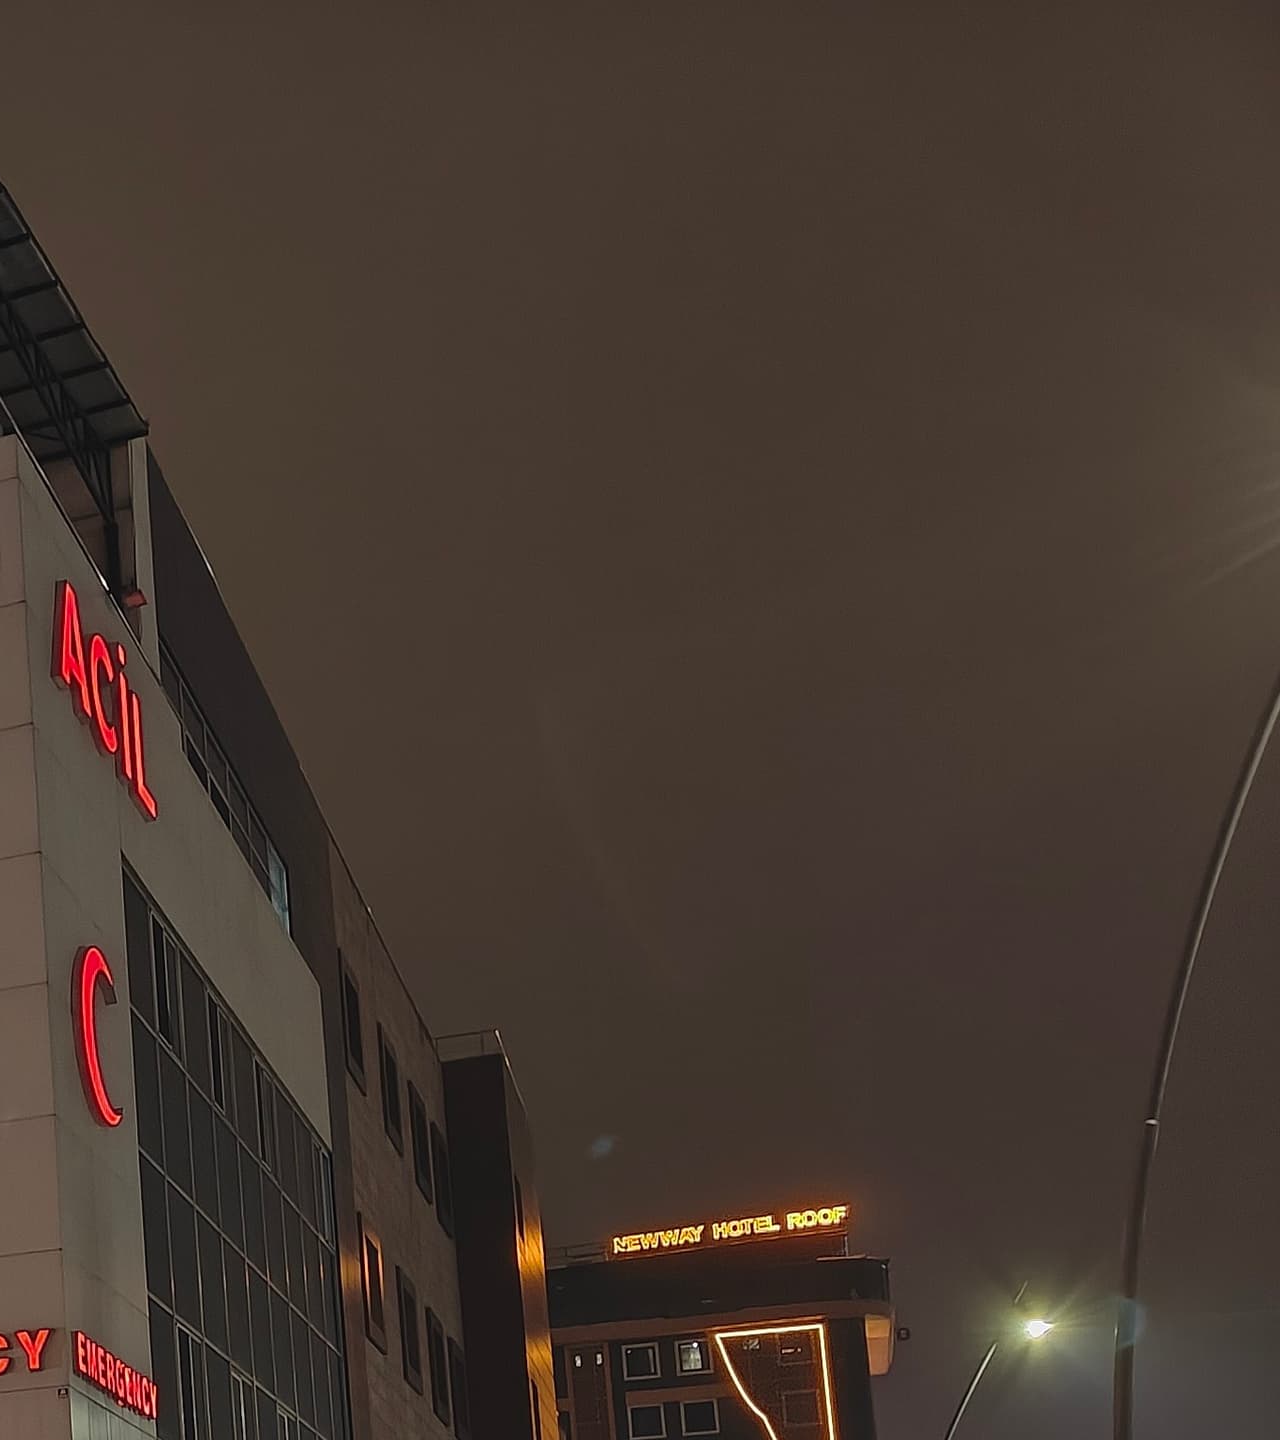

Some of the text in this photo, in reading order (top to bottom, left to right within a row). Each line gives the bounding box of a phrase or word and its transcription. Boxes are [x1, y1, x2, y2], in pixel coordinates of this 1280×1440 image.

[56, 581, 158, 818] ACİL
[613, 1206, 848, 1254] NEWWAY HOTEL ROOF
[75, 1331, 158, 1419] EMERGENCY
